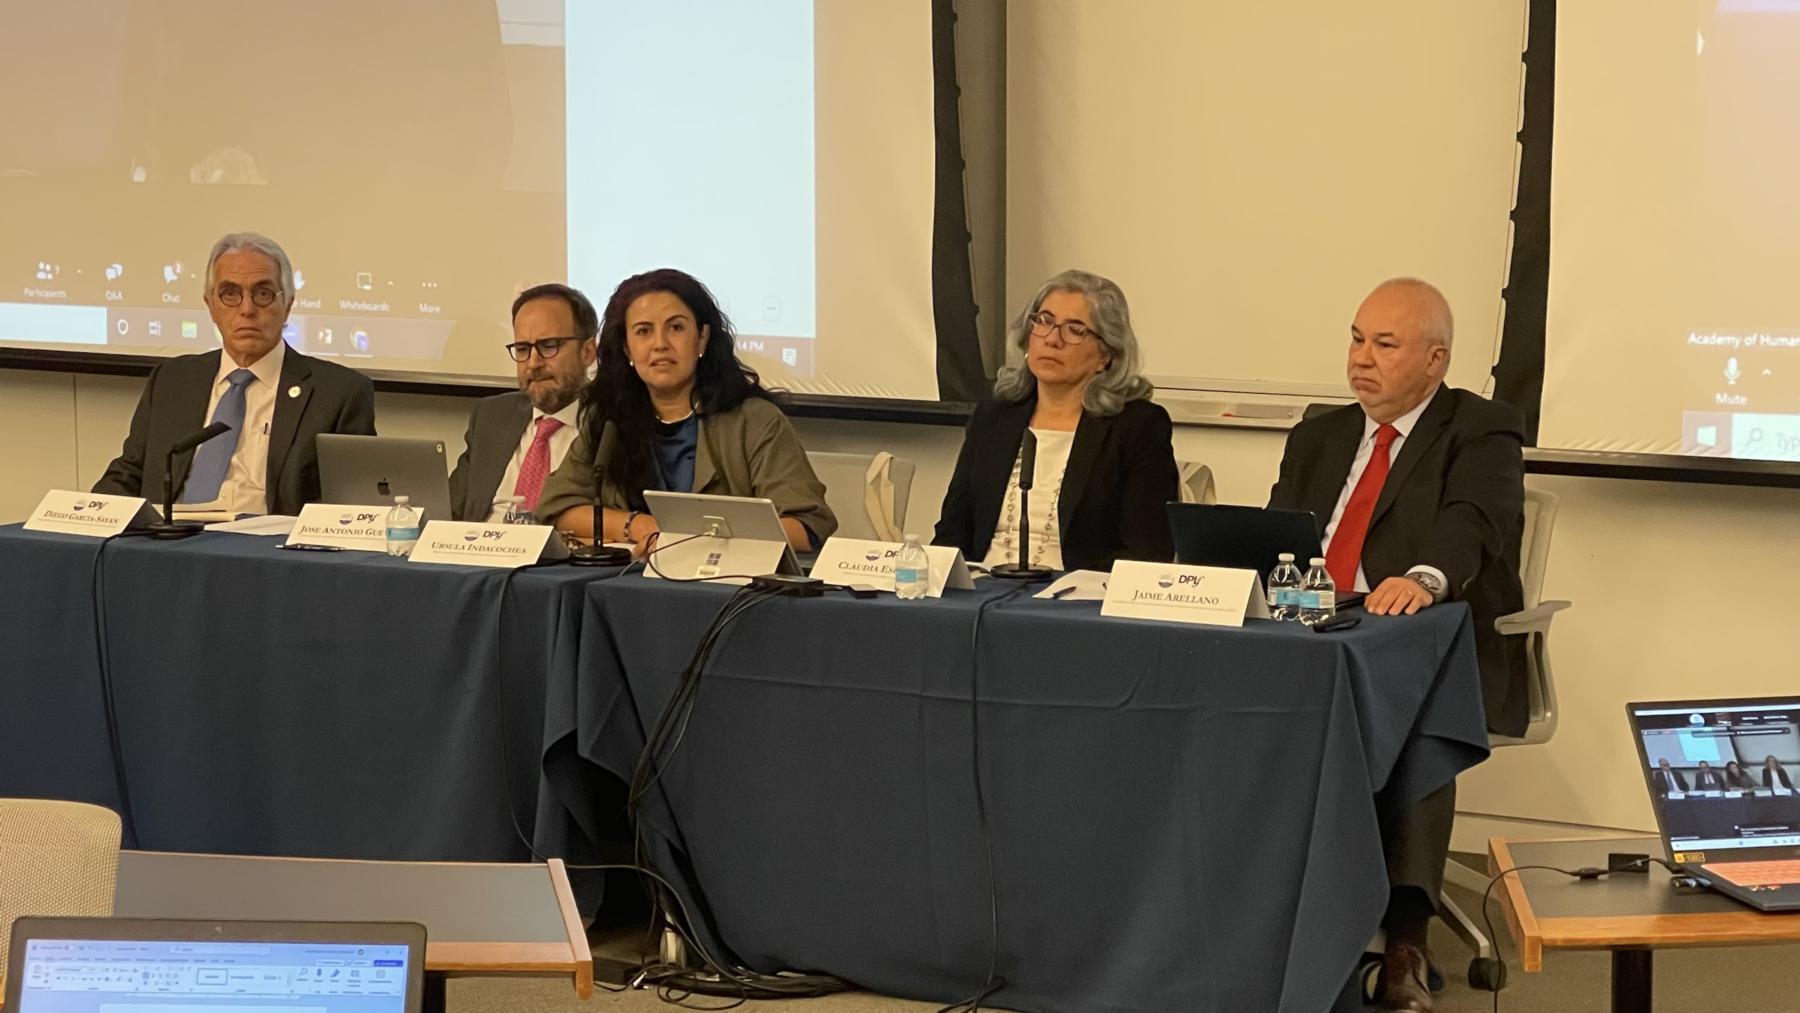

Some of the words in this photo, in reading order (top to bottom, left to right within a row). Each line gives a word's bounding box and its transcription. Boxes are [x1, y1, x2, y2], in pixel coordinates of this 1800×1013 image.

[23, 288, 67, 299] Participants
[162, 292, 181, 303] Chat
[300, 298, 321, 309] Hand
[339, 299, 390, 312] Whiteboards
[419, 303, 441, 314] More
[1687, 332, 1742, 349] Academy
[1744, 333, 1758, 346] of
[1715, 392, 1748, 405] Mute
[299, 525, 320, 534] JOSE
[321, 527, 364, 536] ANTONIO
[431, 541, 466, 551] URSULA
[467, 543, 527, 554] INDACOCHEA
[838, 561, 879, 573] CLAUDIA
[1132, 590, 1163, 601] JAIME
[1164, 593, 1220, 605] ARELLANO
